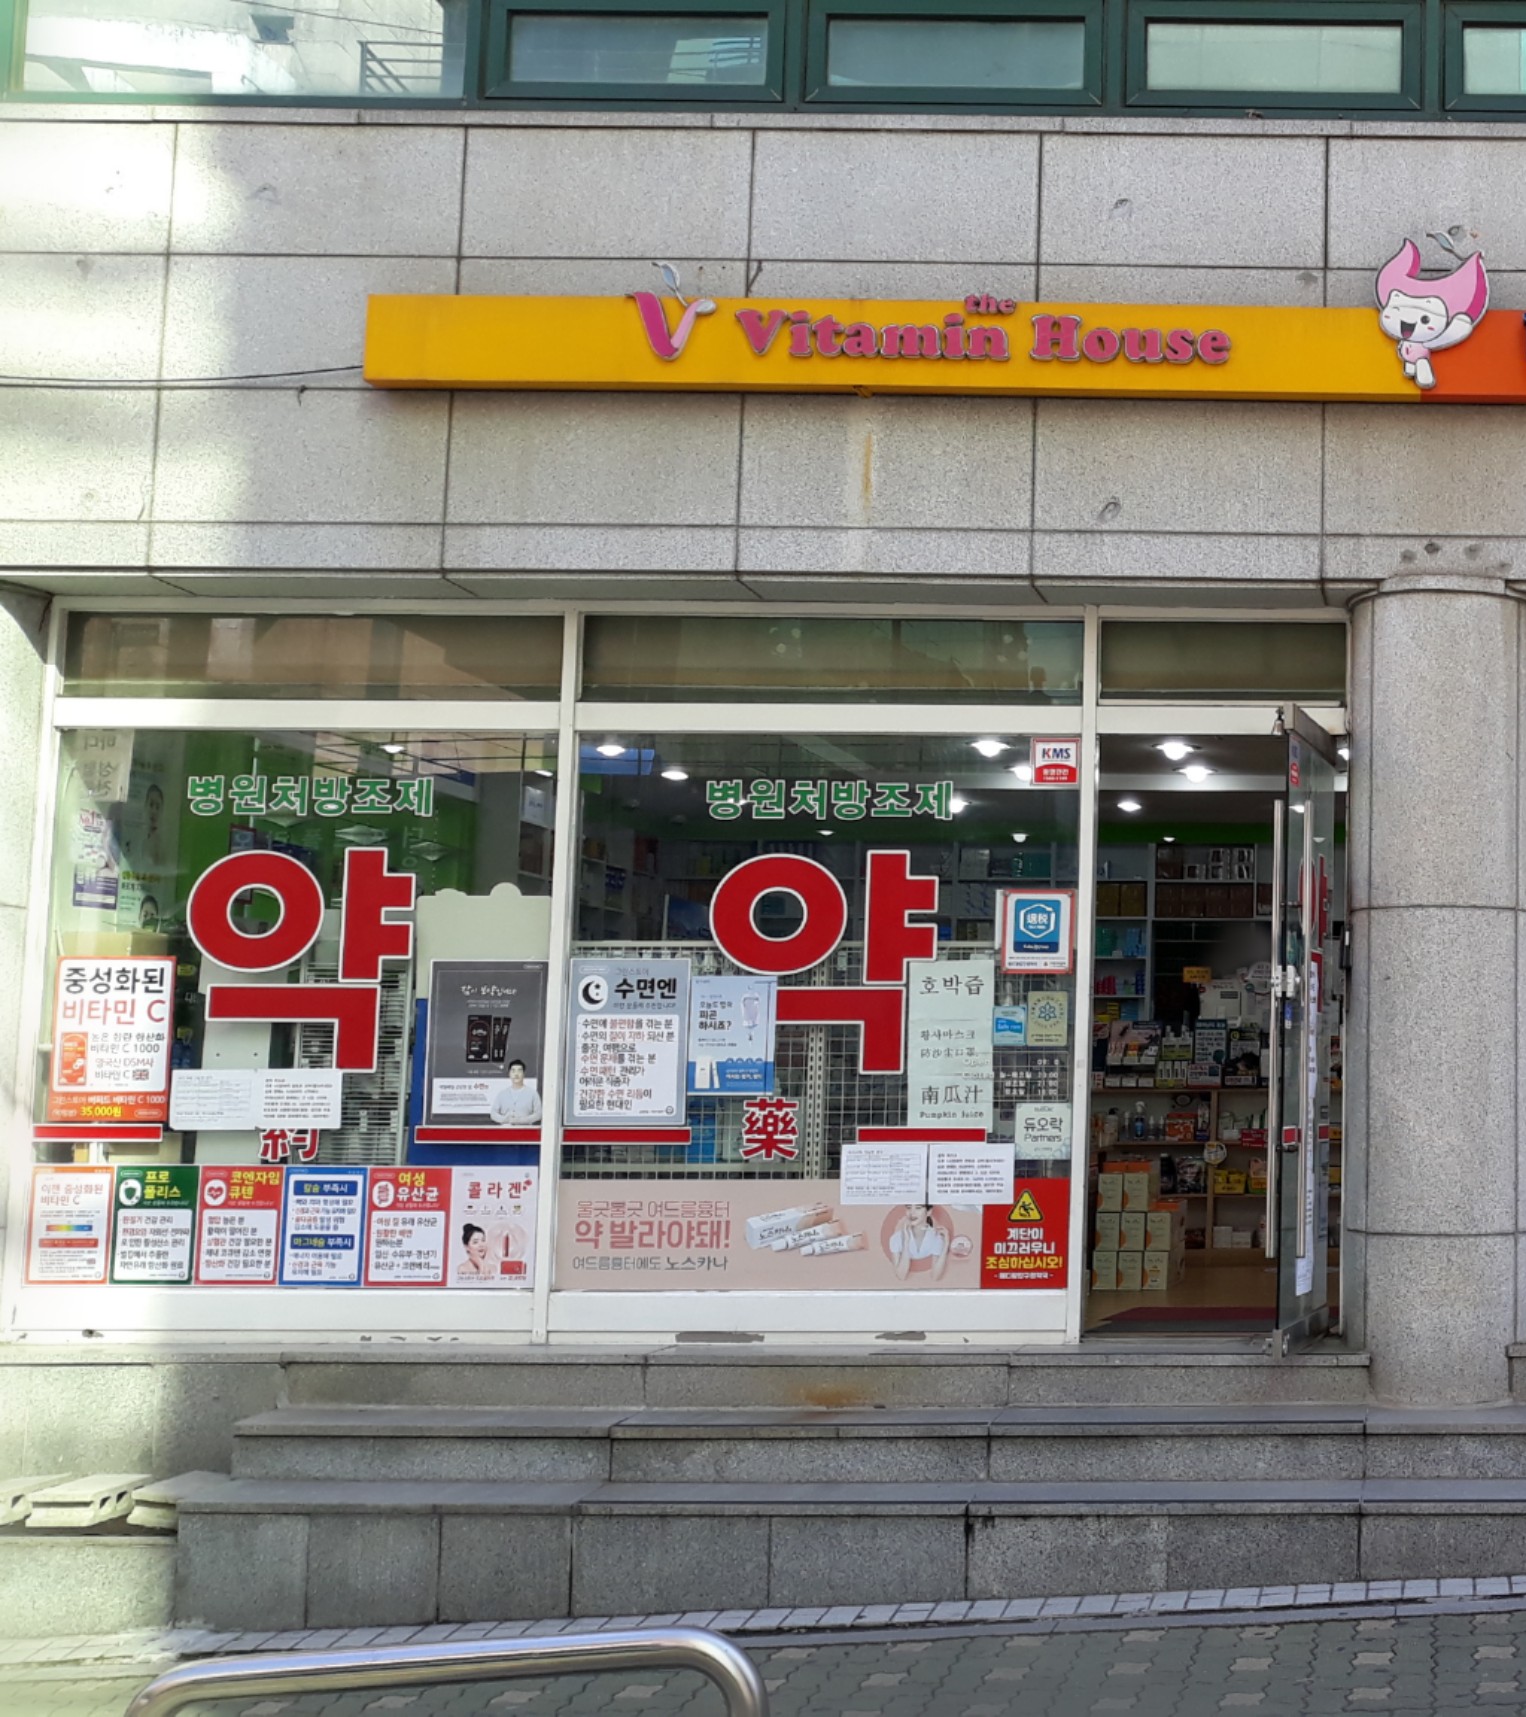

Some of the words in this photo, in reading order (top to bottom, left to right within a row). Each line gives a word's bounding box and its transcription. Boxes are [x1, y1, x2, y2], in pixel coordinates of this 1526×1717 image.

[964, 292, 1016, 316] the
[735, 309, 1010, 362] Vitamin
[1029, 313, 1232, 365] House
[1042, 747, 1072, 760] KMS
[188, 775, 433, 817] 병원처방조제
[706, 778, 953, 820] 병원처방조제
[186, 847, 416, 1073] 약
[709, 850, 939, 1075] 약
[63, 967, 164, 994] 중성화된
[920, 974, 984, 996] 호박즙
[614, 977, 677, 1000] 수면엔
[63, 999, 135, 1025] 비타민
[147, 999, 165, 1022] C
[582, 1019, 607, 1030] 수면에
[664, 1019, 673, 1030] 분
[698, 1020, 732, 1030] 하시죠?
[920, 1029, 976, 1041] 황사마스크
[91, 1043, 120, 1053] 비타민
[133, 1043, 160, 1053] 1000
[921, 1085, 983, 1105] 南瓜汁
[920, 1111, 957, 1119] Pumpkin
[740, 1096, 799, 1160] 藥
[1024, 1118, 1063, 1133] 듀오락
[1024, 1133, 1062, 1143] Partners
[144, 1171, 171, 1183] 프로
[230, 1170, 280, 1185] 코엔자임
[398, 1172, 426, 1187] 여성
[143, 1185, 181, 1199] 폴리스
[229, 1186, 254, 1199] 큐텐
[397, 1186, 439, 1202] 유산균
[648, 1201, 730, 1218] 여드름흉터
[575, 1220, 603, 1249] 약
[610, 1220, 731, 1249] 발라야돼!
[1007, 1228, 1044, 1241] 계단이
[993, 1242, 1055, 1255] 미끄러우니
[573, 1256, 661, 1271] 여드름흉터에도
[665, 1256, 728, 1271] 노스카나
[985, 1256, 1063, 1269] 조심하십시오!
